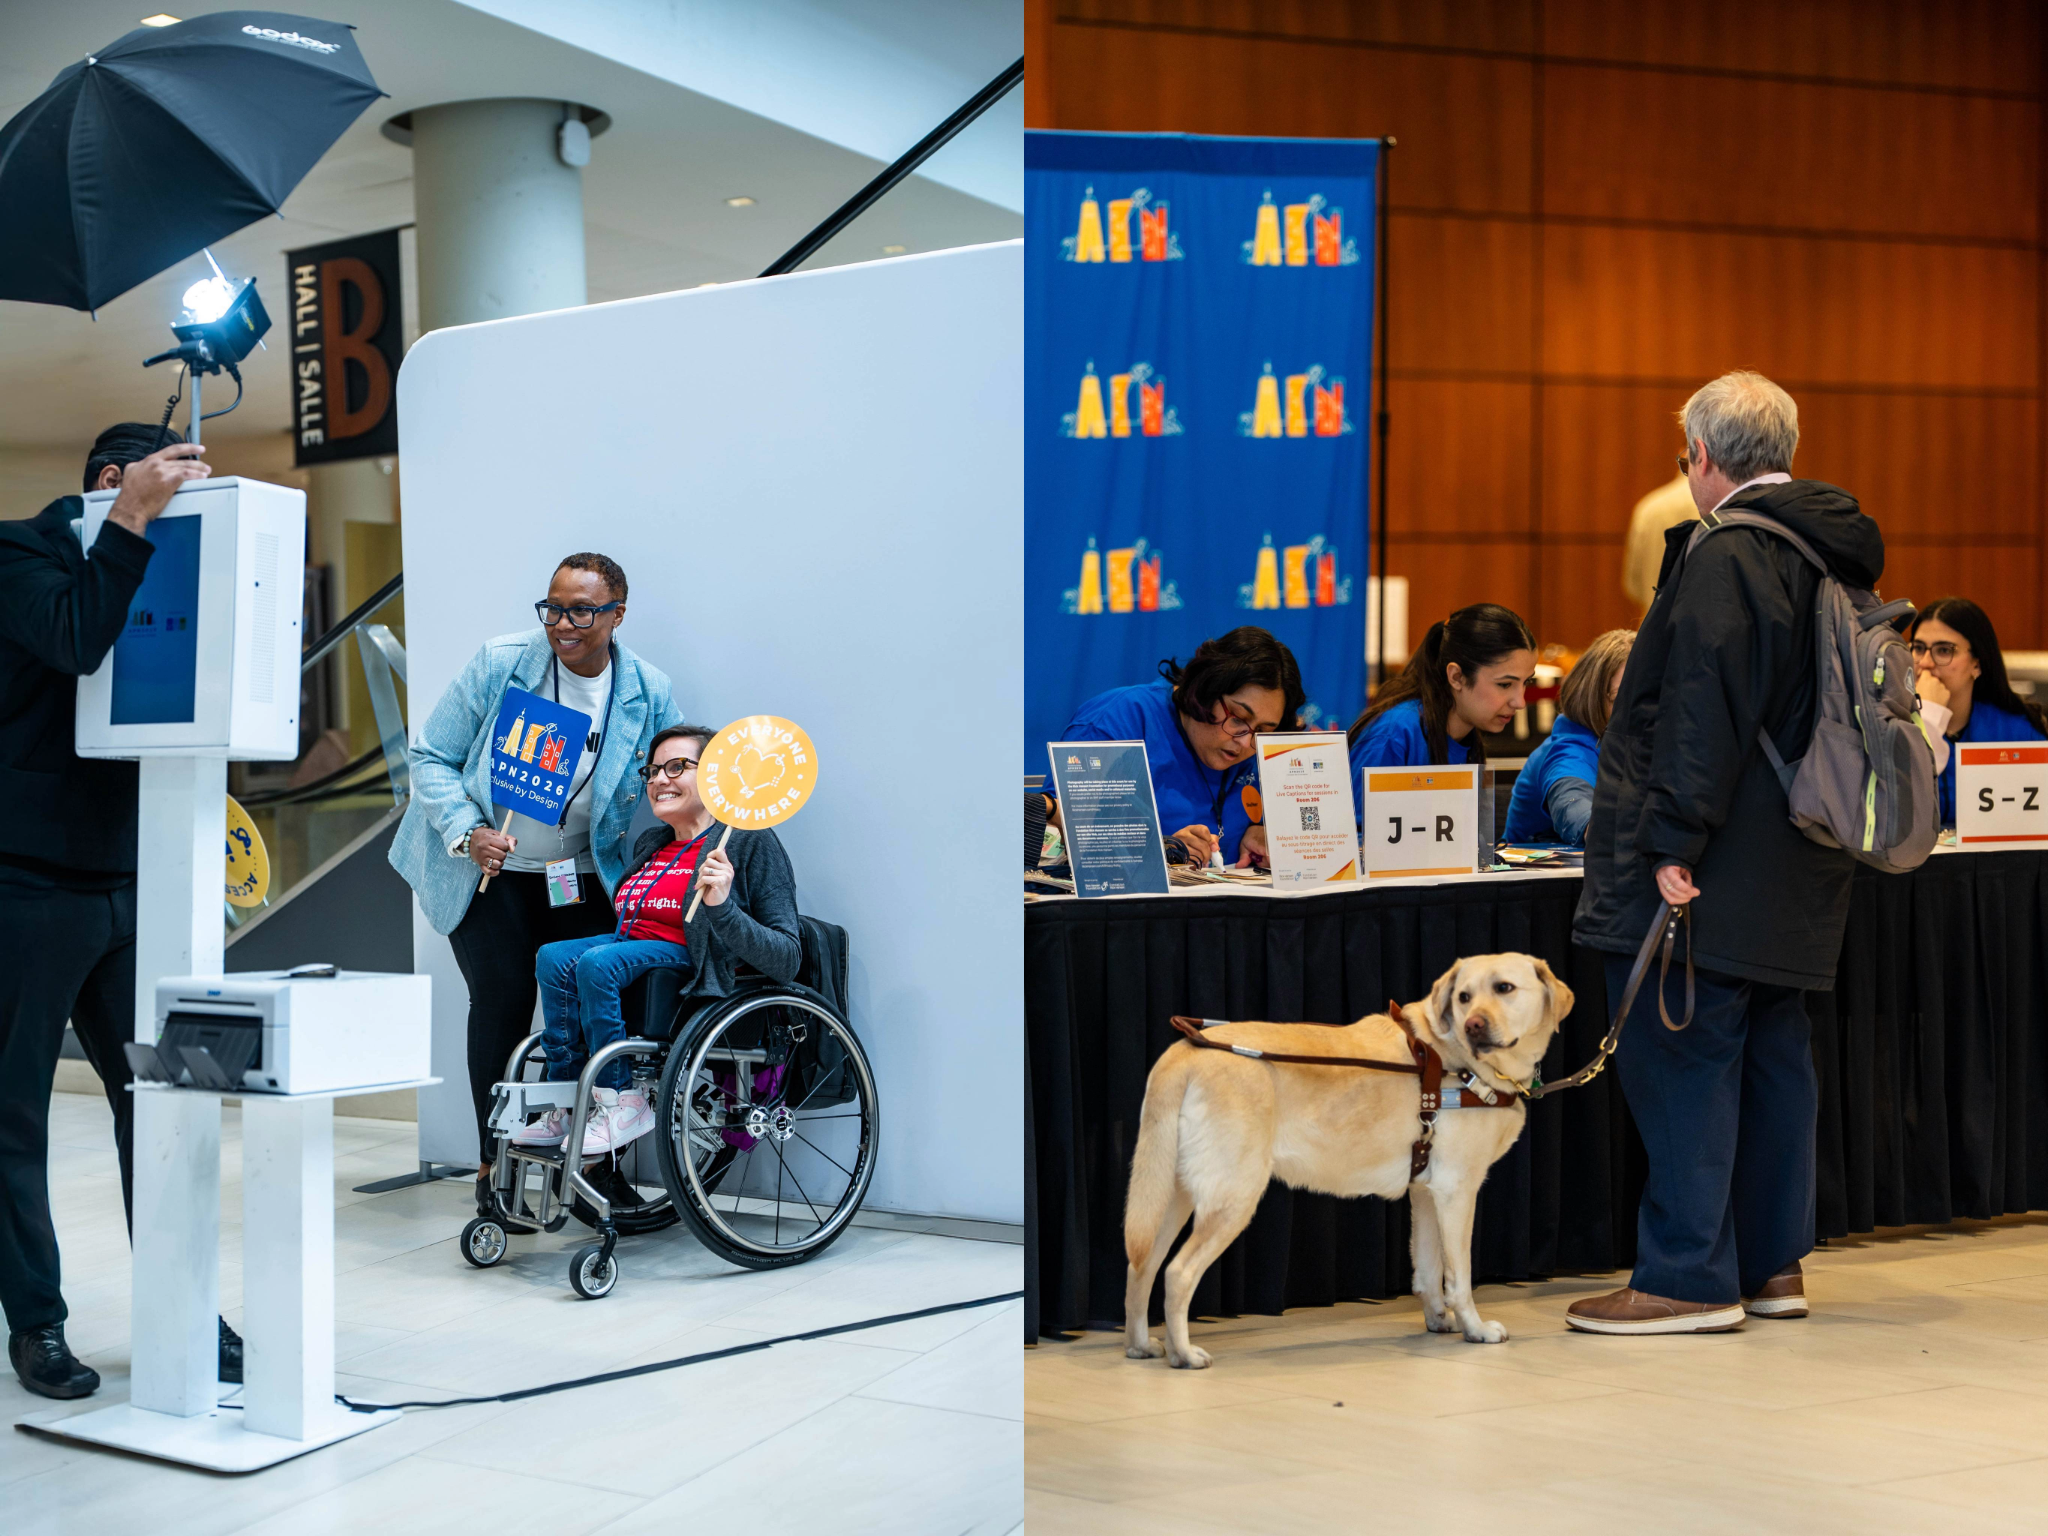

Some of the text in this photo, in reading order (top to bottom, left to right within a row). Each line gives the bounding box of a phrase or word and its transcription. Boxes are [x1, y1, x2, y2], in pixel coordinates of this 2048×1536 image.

[294, 264, 318, 338] HALL
[320, 256, 391, 440] B
[298, 359, 324, 448] SALLE
[727, 724, 807, 766] EVERYONE
[491, 774, 559, 810] clusive by Design
[706, 763, 801, 821] EVERYWHERE
[1978, 787, 1995, 813] S
[2022, 786, 2039, 811] Z
[1387, 816, 1402, 844] J
[1435, 815, 1454, 842] R
[647, 897, 681, 909] right.
